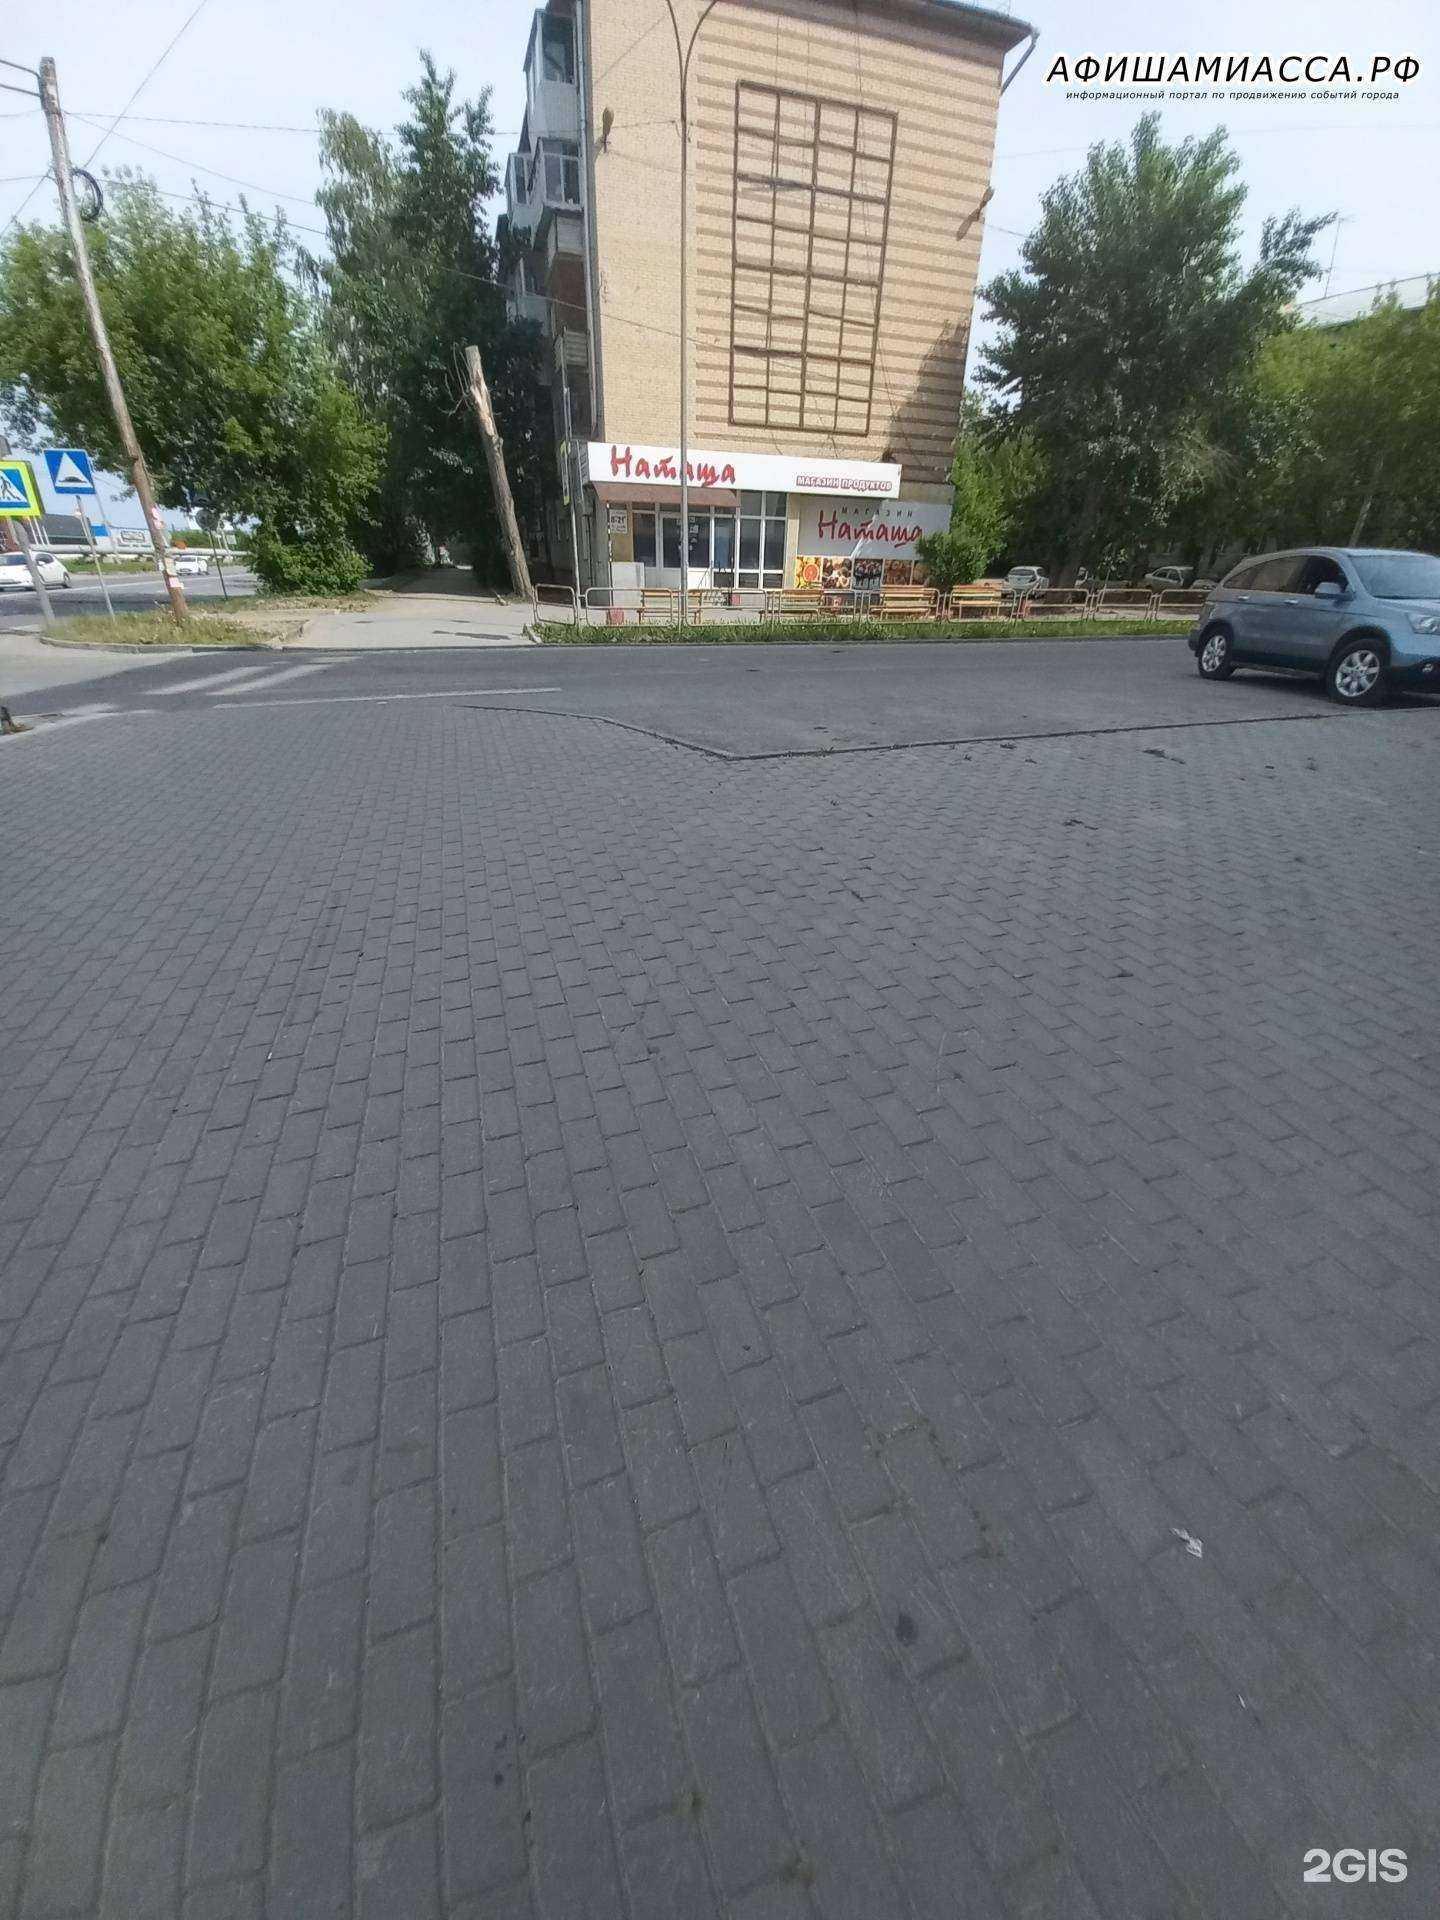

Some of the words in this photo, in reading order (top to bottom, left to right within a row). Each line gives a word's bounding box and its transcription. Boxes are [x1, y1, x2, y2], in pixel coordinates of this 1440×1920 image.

[796, 475, 839, 488] МАГАЗИН
[841, 478, 892, 492] ПРОДУКТОВ
[842, 506, 913, 517] МАГАЗИН
[818, 510, 922, 548] Наташа
